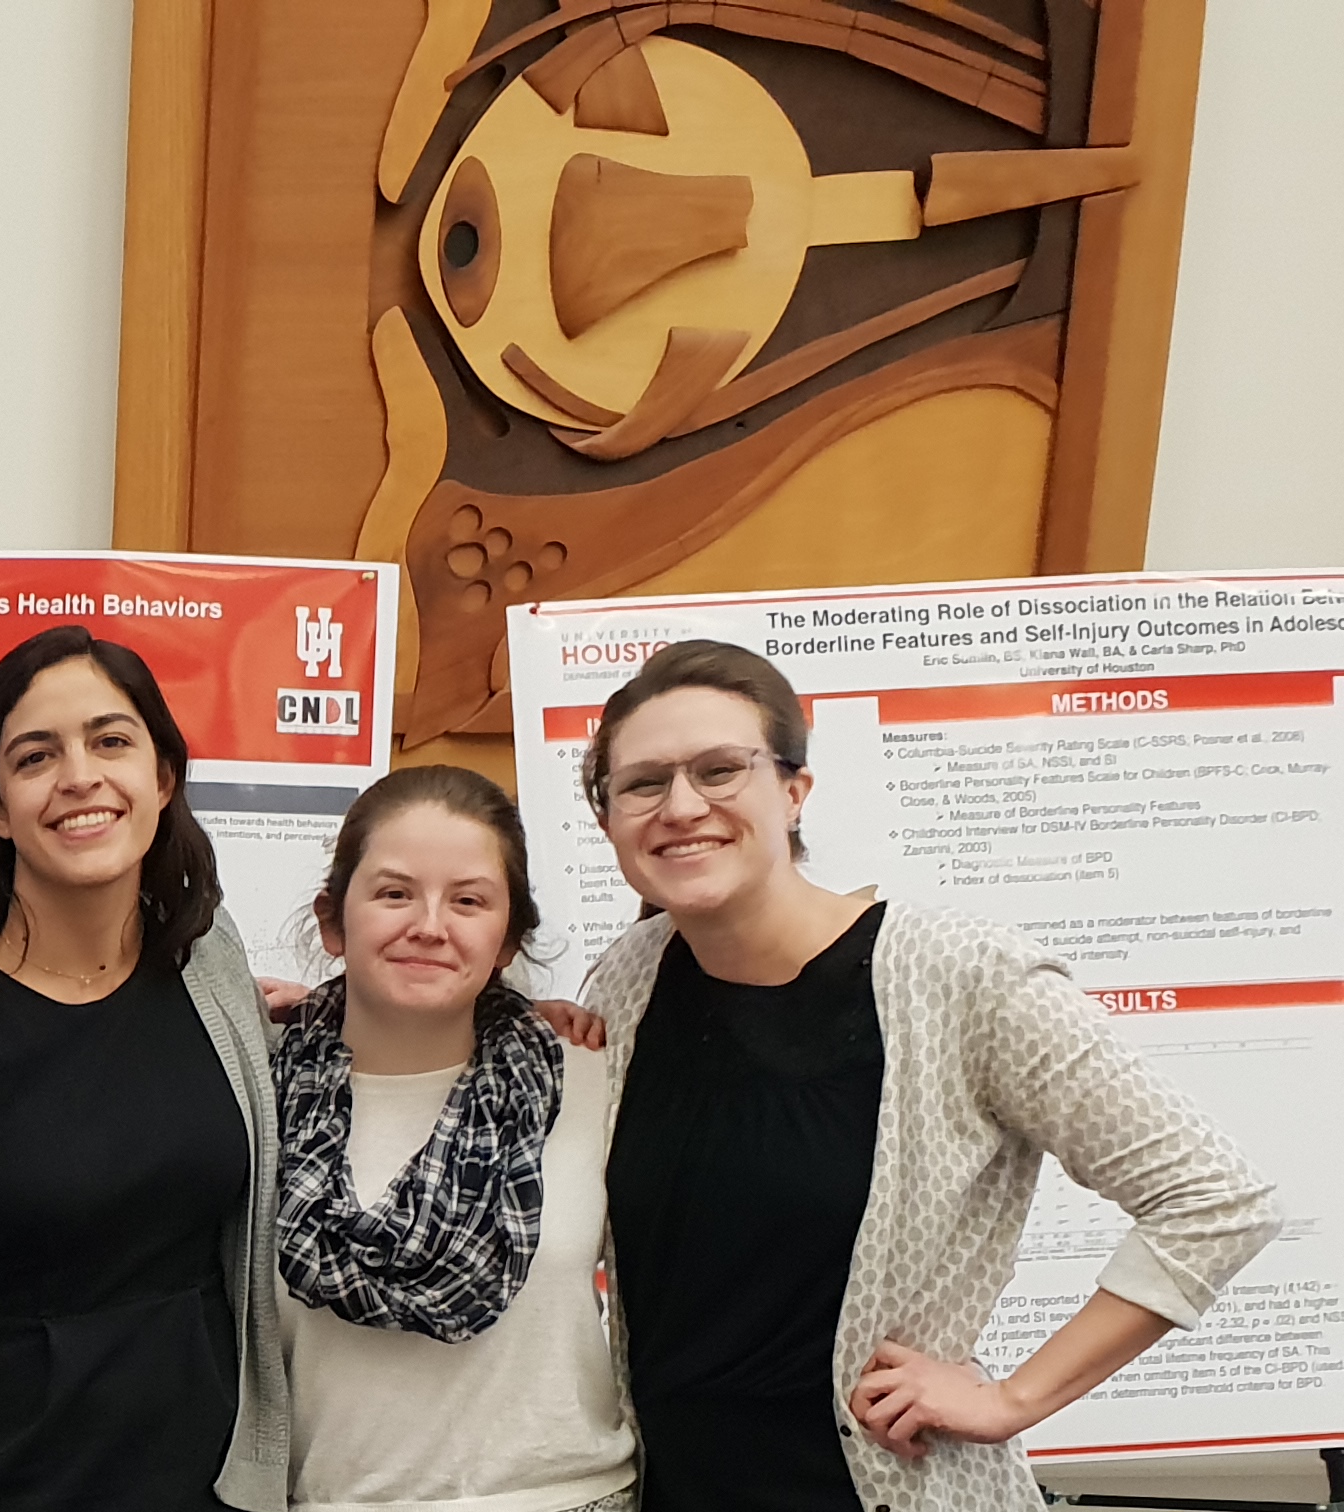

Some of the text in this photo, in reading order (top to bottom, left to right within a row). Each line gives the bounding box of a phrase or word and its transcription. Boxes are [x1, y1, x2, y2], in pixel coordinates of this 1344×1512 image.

[18, 593, 95, 615] Health
[103, 594, 223, 619] Behaviors
[766, 611, 806, 629] The
[813, 604, 929, 628] Moderating
[938, 602, 985, 620] Role
[991, 599, 1012, 618] of
[1018, 593, 1146, 616] Dissociation
[1153, 593, 1170, 610] in
[1177, 591, 1208, 610] the
[562, 628, 670, 642] UNVERSITY
[766, 634, 875, 656] Borderline
[882, 630, 973, 650] Features
[980, 626, 1018, 645] and
[1025, 621, 1130, 644] Self-Injury
[1137, 616, 1240, 638] Outcomes
[1246, 615, 1263, 634] in
[923, 654, 948, 666] Eric
[1220, 641, 1246, 653] PhD
[1020, 662, 1155, 677] University of Houston
[278, 695, 358, 725] CNDL
[1052, 690, 1168, 713] METHODS
[882, 732, 948, 743] Measures:
[900, 779, 960, 791] Borderline
[229, 817, 264, 827] towards
[266, 817, 295, 828] health
[297, 819, 338, 829] behaviors
[902, 826, 962, 840] Childhood
[1086, 989, 1178, 1013] SULTS
[1031, 1294, 1080, 1308] reported
